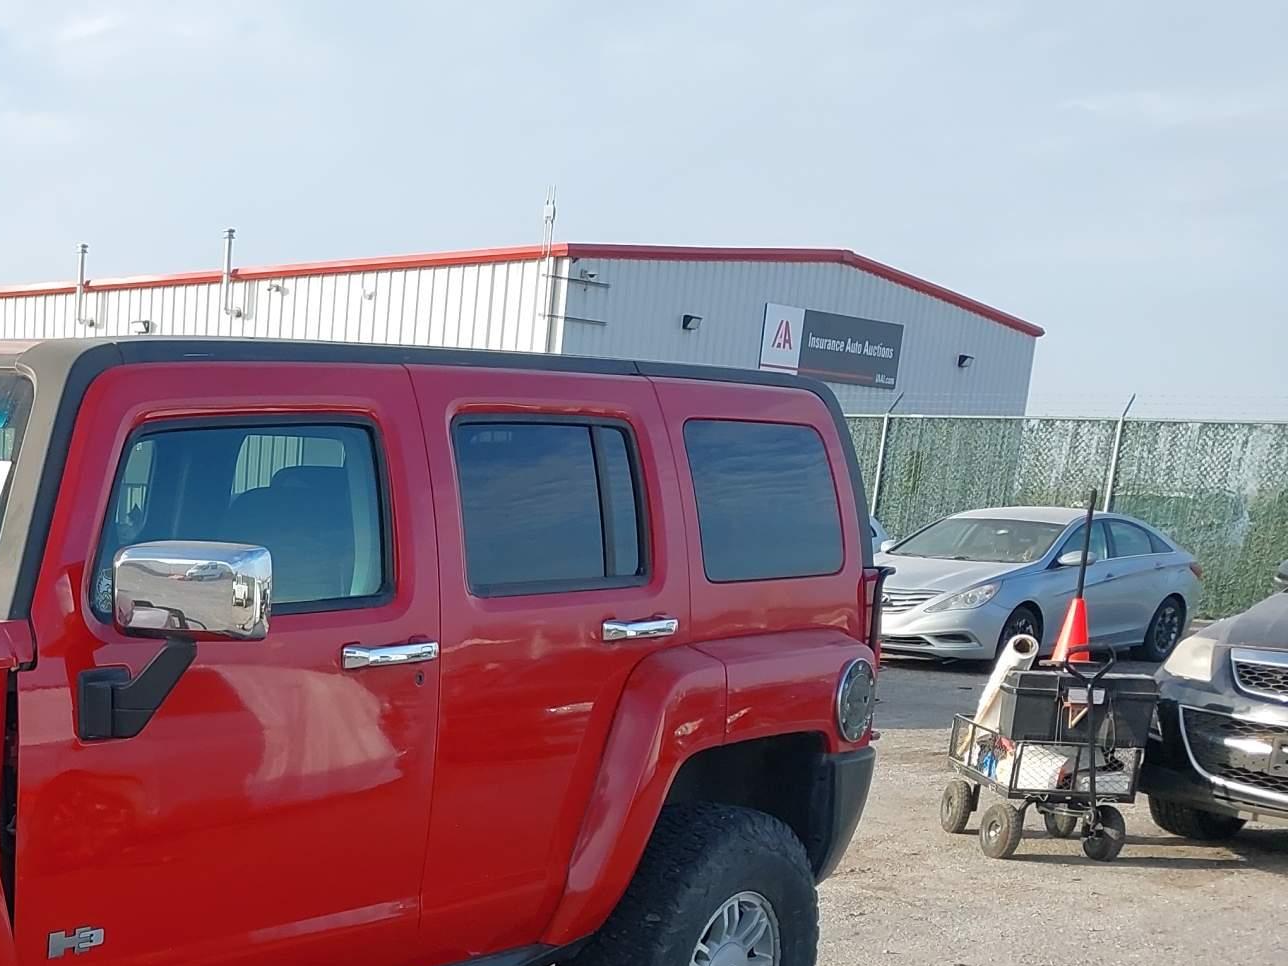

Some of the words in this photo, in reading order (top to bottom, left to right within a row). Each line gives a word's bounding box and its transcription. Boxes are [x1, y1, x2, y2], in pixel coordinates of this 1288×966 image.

[808, 332, 844, 352] Insurance
[845, 338, 862, 354] Auto
[863, 341, 894, 359] Auctions
[48, 926, 105, 960] H3
